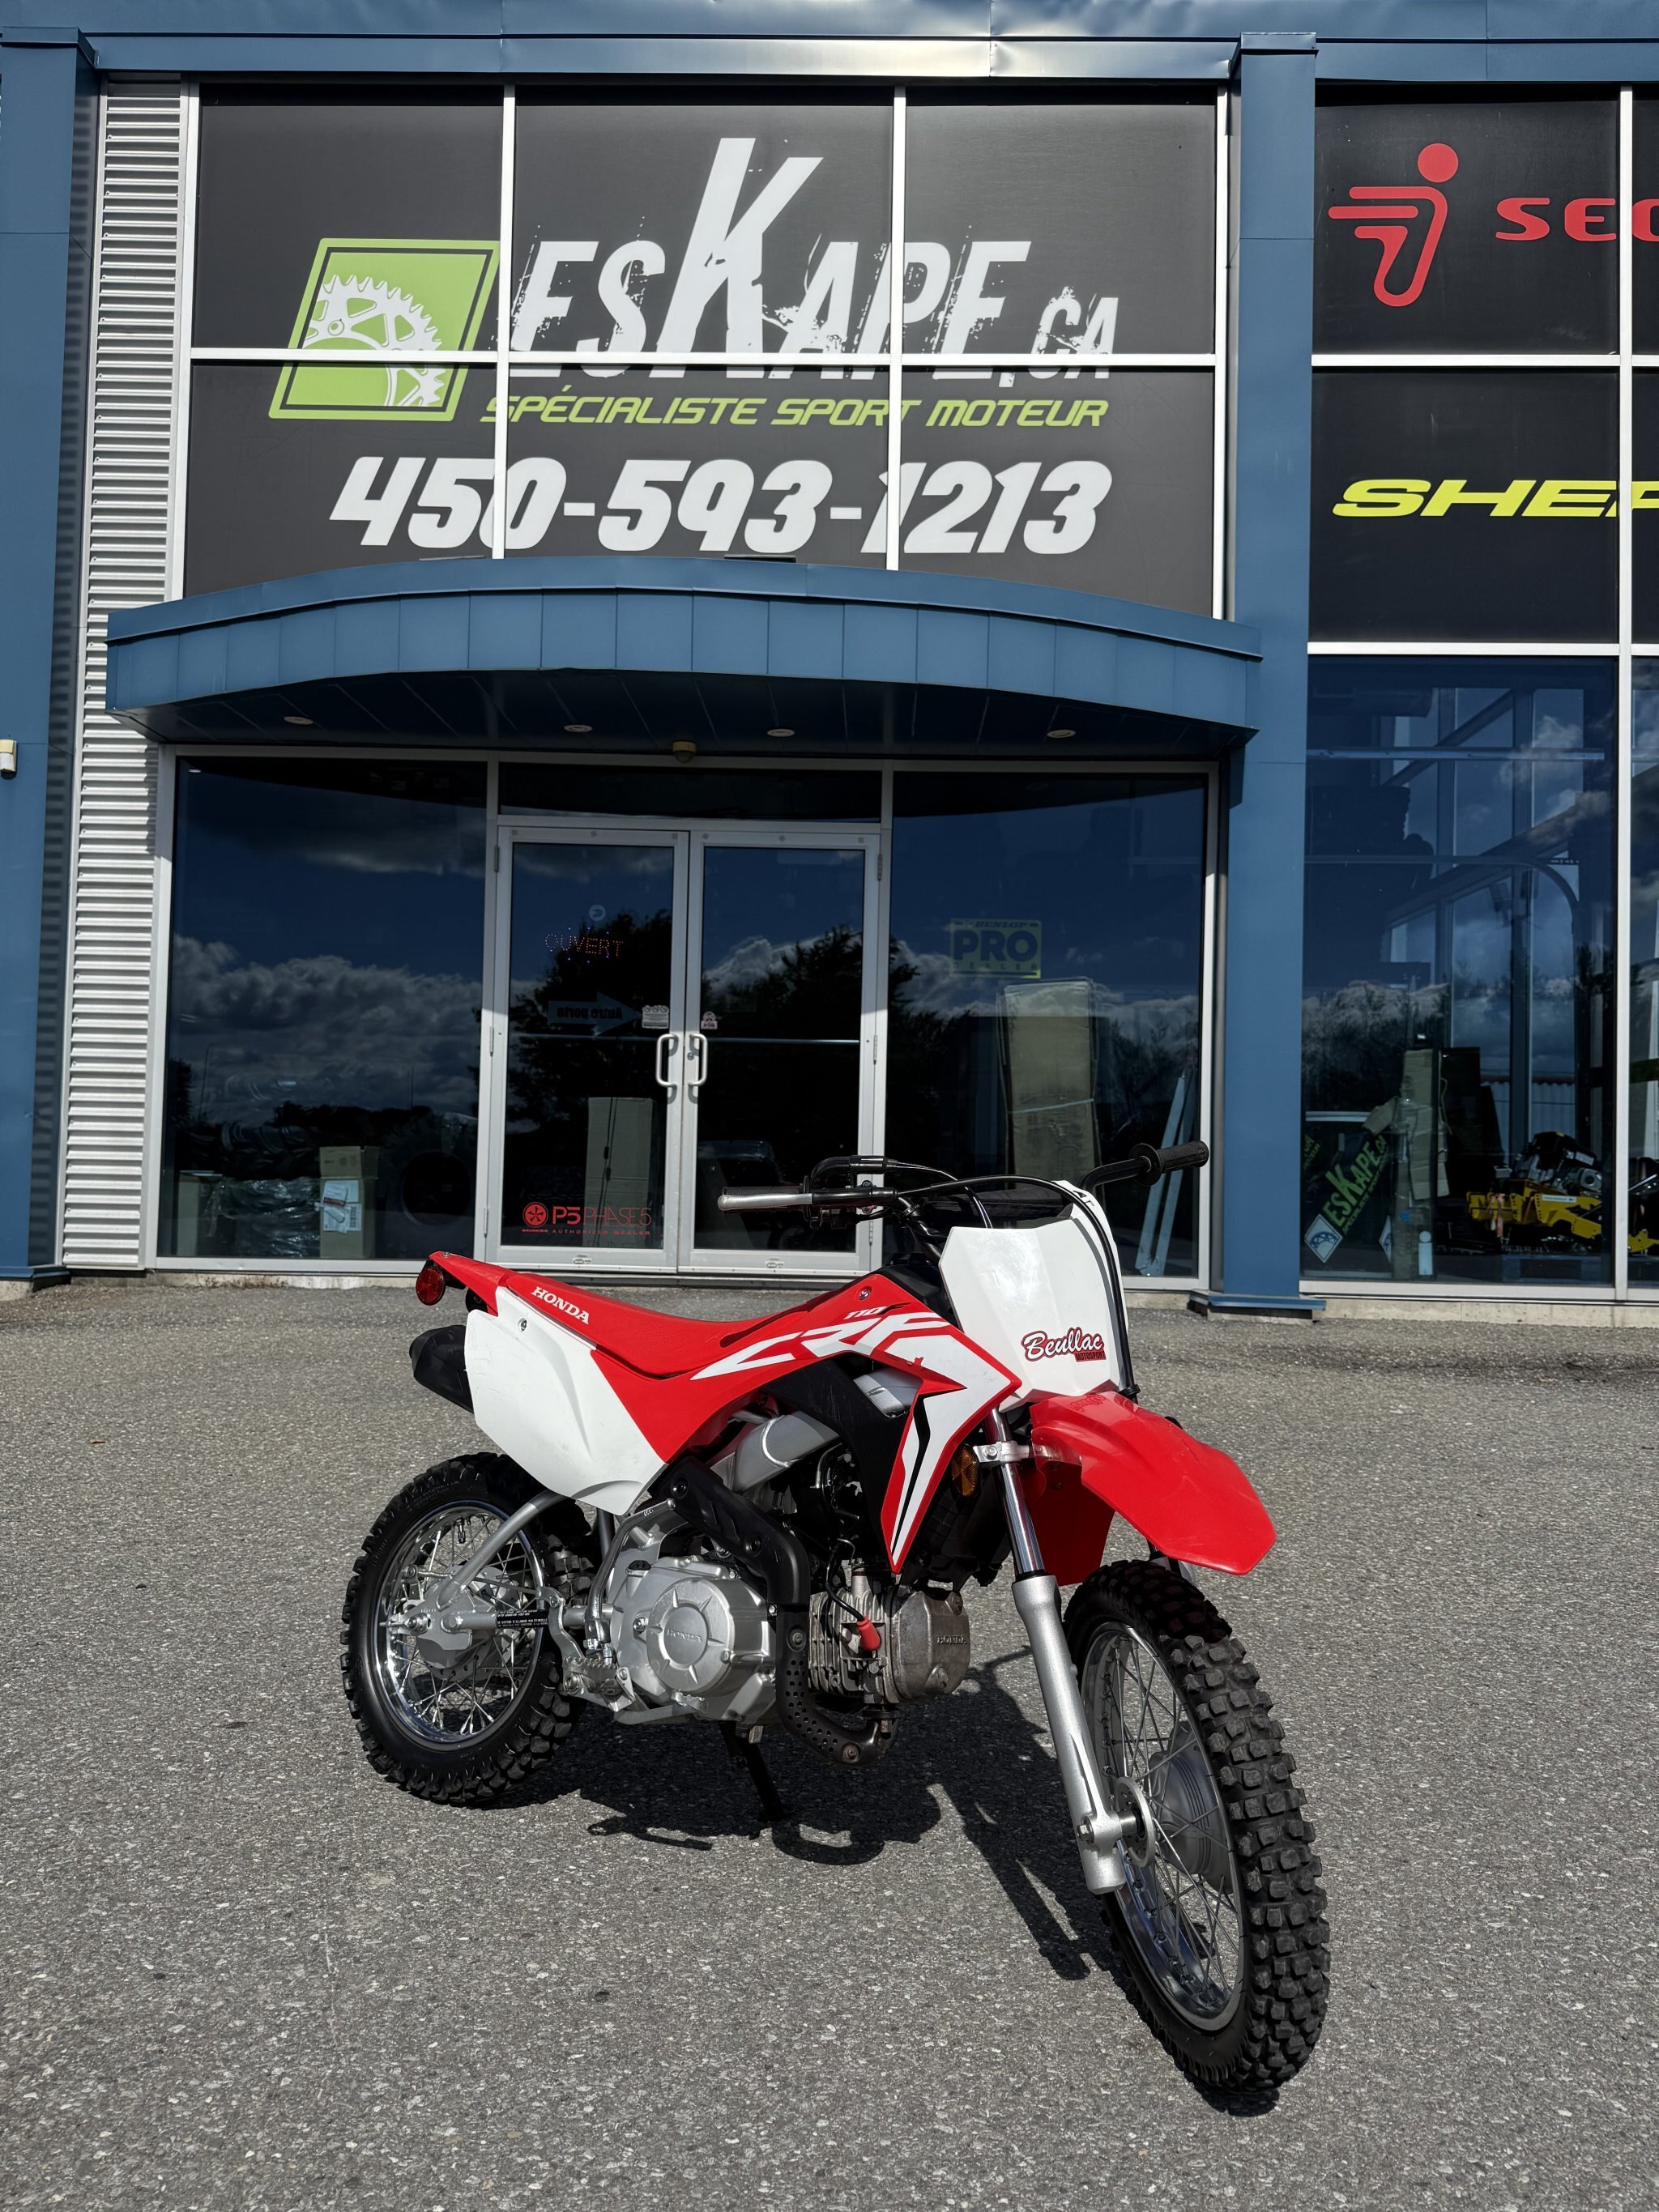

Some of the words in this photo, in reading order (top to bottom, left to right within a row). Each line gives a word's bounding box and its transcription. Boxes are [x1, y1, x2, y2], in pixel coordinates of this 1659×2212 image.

[480, 384, 766, 425] SPÉCIALISTE
[770, 398, 921, 427] SPORT
[926, 399, 1109, 428] MOTEUR
[330, 456, 1112, 555] 450-593-1213
[544, 933, 623, 958] OUVERT
[953, 930, 1038, 962] PRO
[954, 962, 1037, 970] DEALER
[552, 1206, 581, 1225] P5
[531, 1286, 590, 1325] HONDA
[690, 1311, 951, 1381] CRF
[1021, 1328, 1104, 1362] Beullac
[1075, 1351, 1107, 1362] MOTOSPORT
[666, 1629, 703, 1643] HONDA
